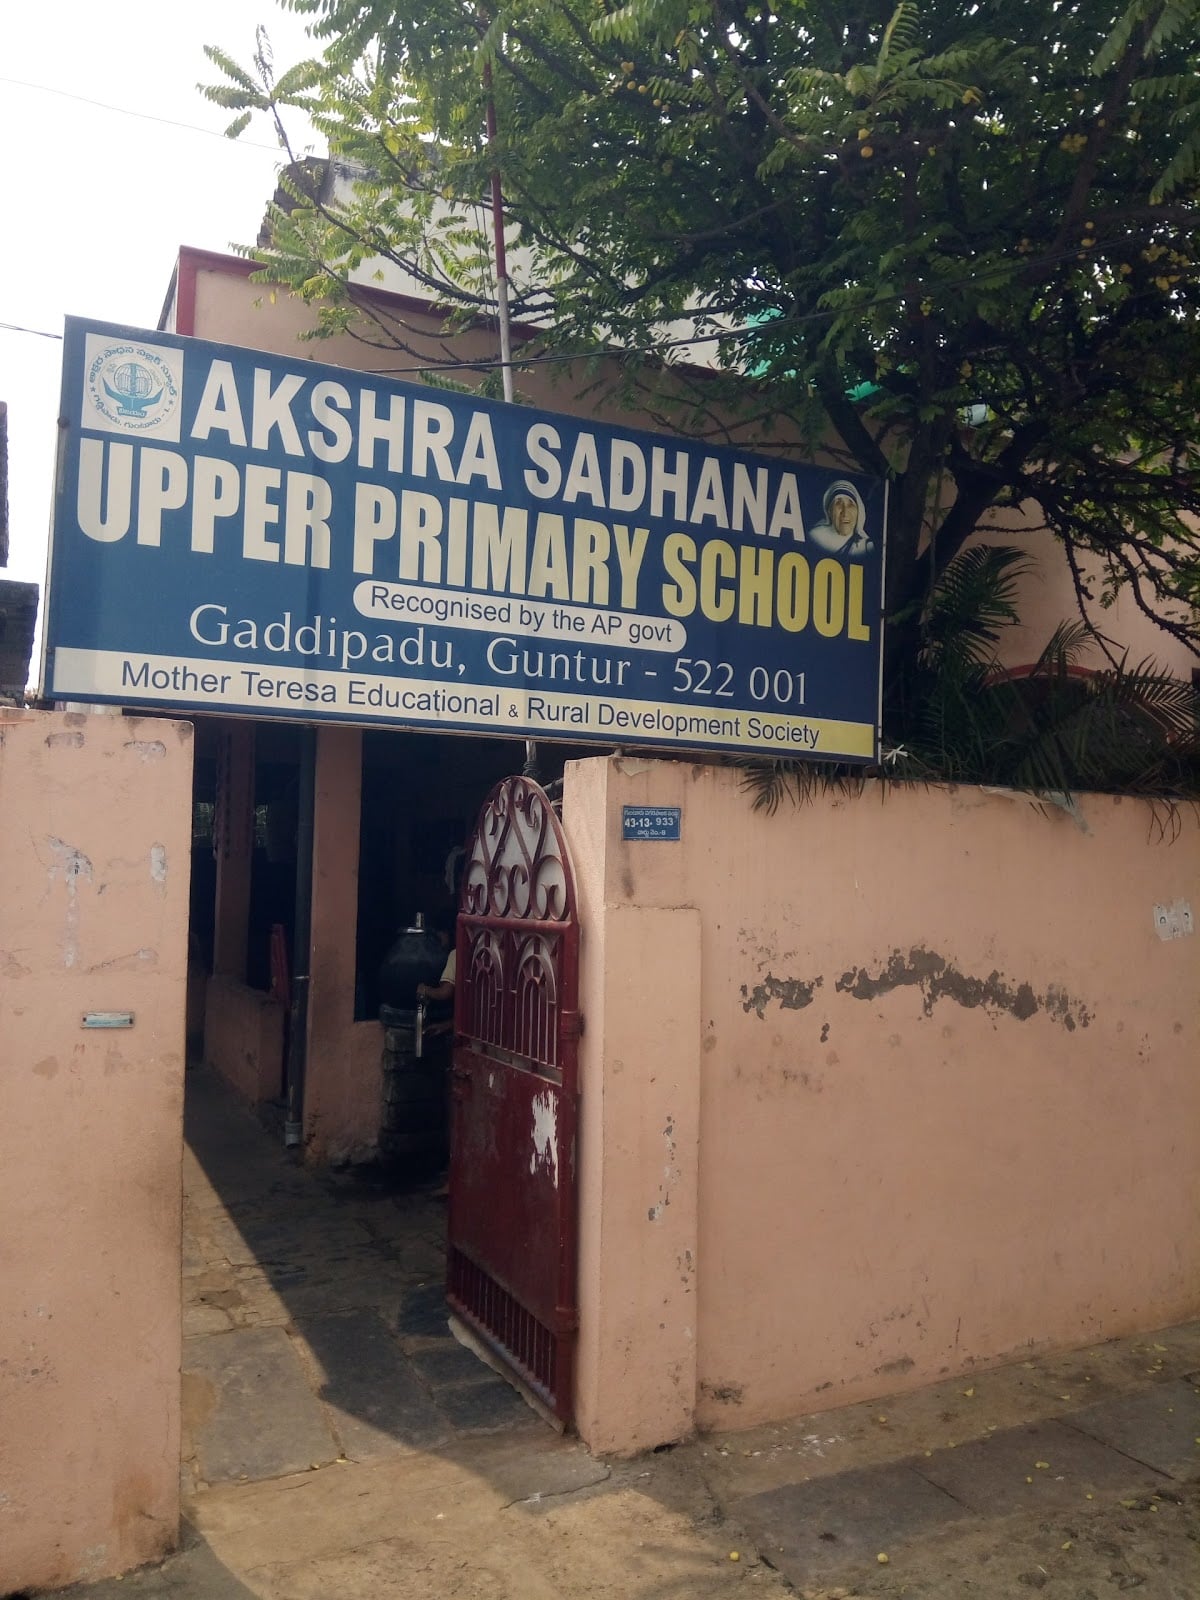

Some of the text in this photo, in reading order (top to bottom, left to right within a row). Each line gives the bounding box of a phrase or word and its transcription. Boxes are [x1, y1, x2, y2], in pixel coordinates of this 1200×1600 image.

[190, 359, 805, 542] AKSHRA SADHANA
[77, 438, 870, 641] UPPER PRIMARY SCHOOL
[189, 603, 466, 676] Gaddipadu,
[486, 637, 631, 686] Guntur
[672, 658, 735, 697] 522
[749, 666, 806, 705] 001
[371, 585, 673, 644] Recognised by the AP govt
[122, 660, 820, 749] Mother Teresa Educational & Rural Development Society
